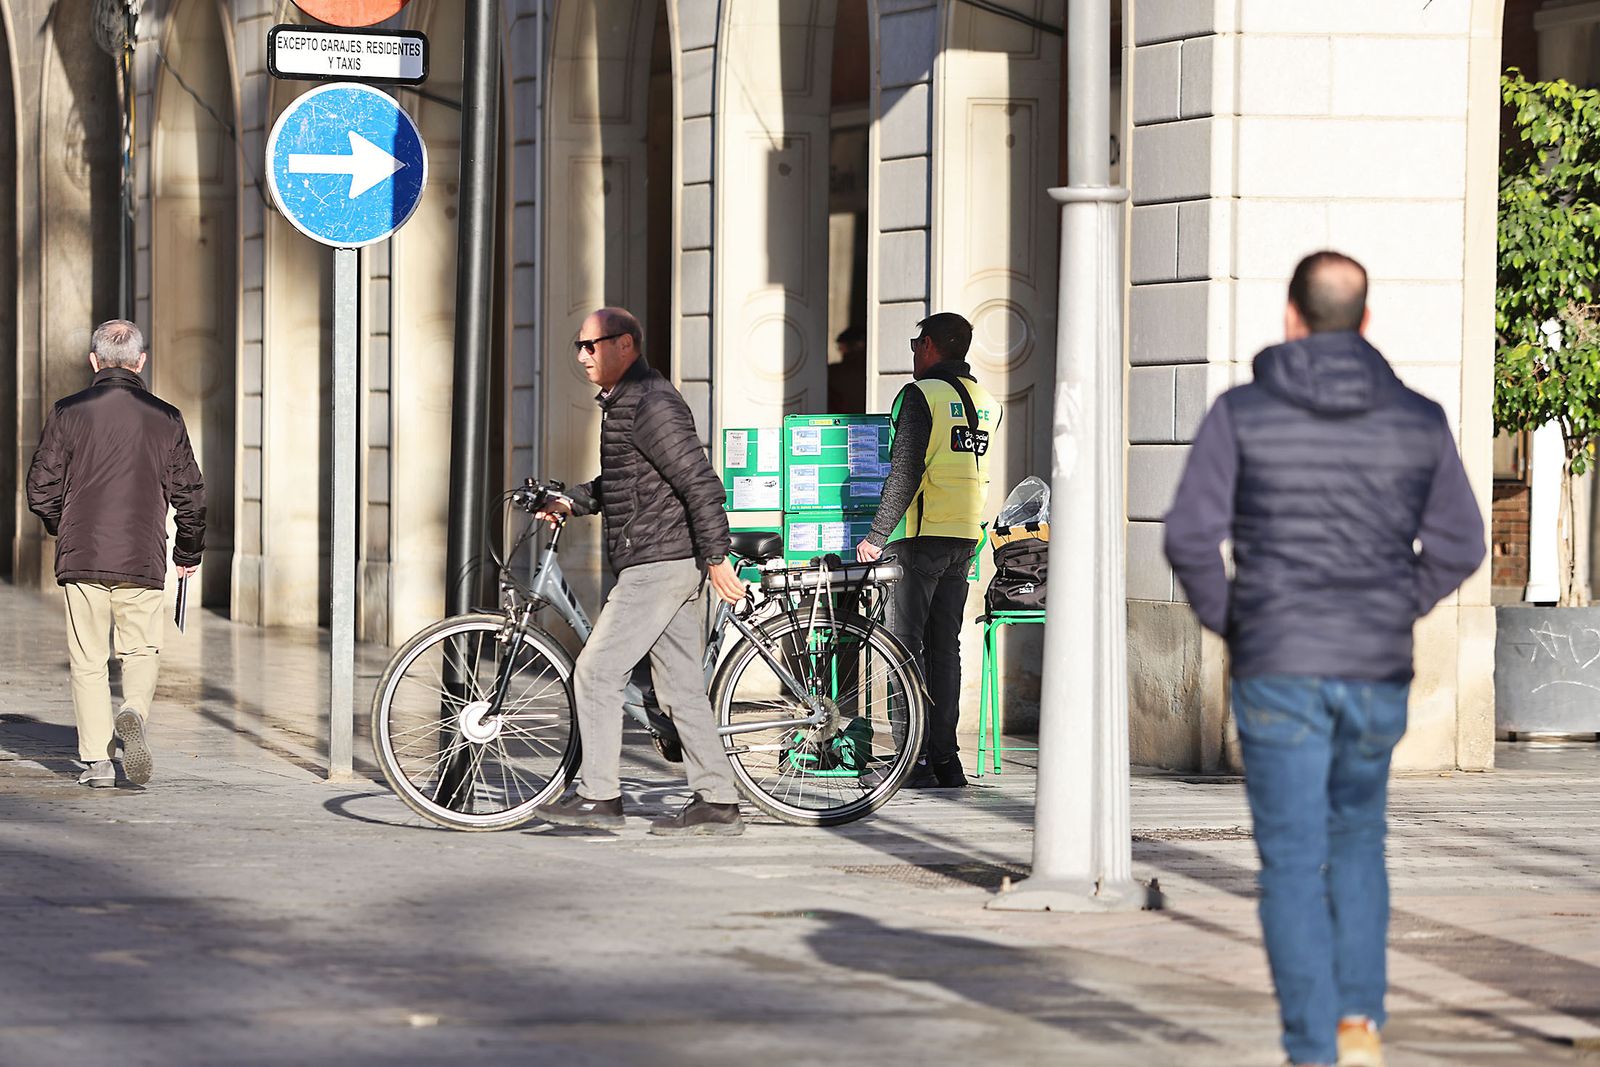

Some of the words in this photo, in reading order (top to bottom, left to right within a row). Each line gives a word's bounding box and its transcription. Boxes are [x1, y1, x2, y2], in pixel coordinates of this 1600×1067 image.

[277, 36, 318, 51] EXCEPTO
[366, 40, 420, 56] RESIDENTES
[328, 56, 334, 69] Y
[336, 56, 361, 71] TAXIS
